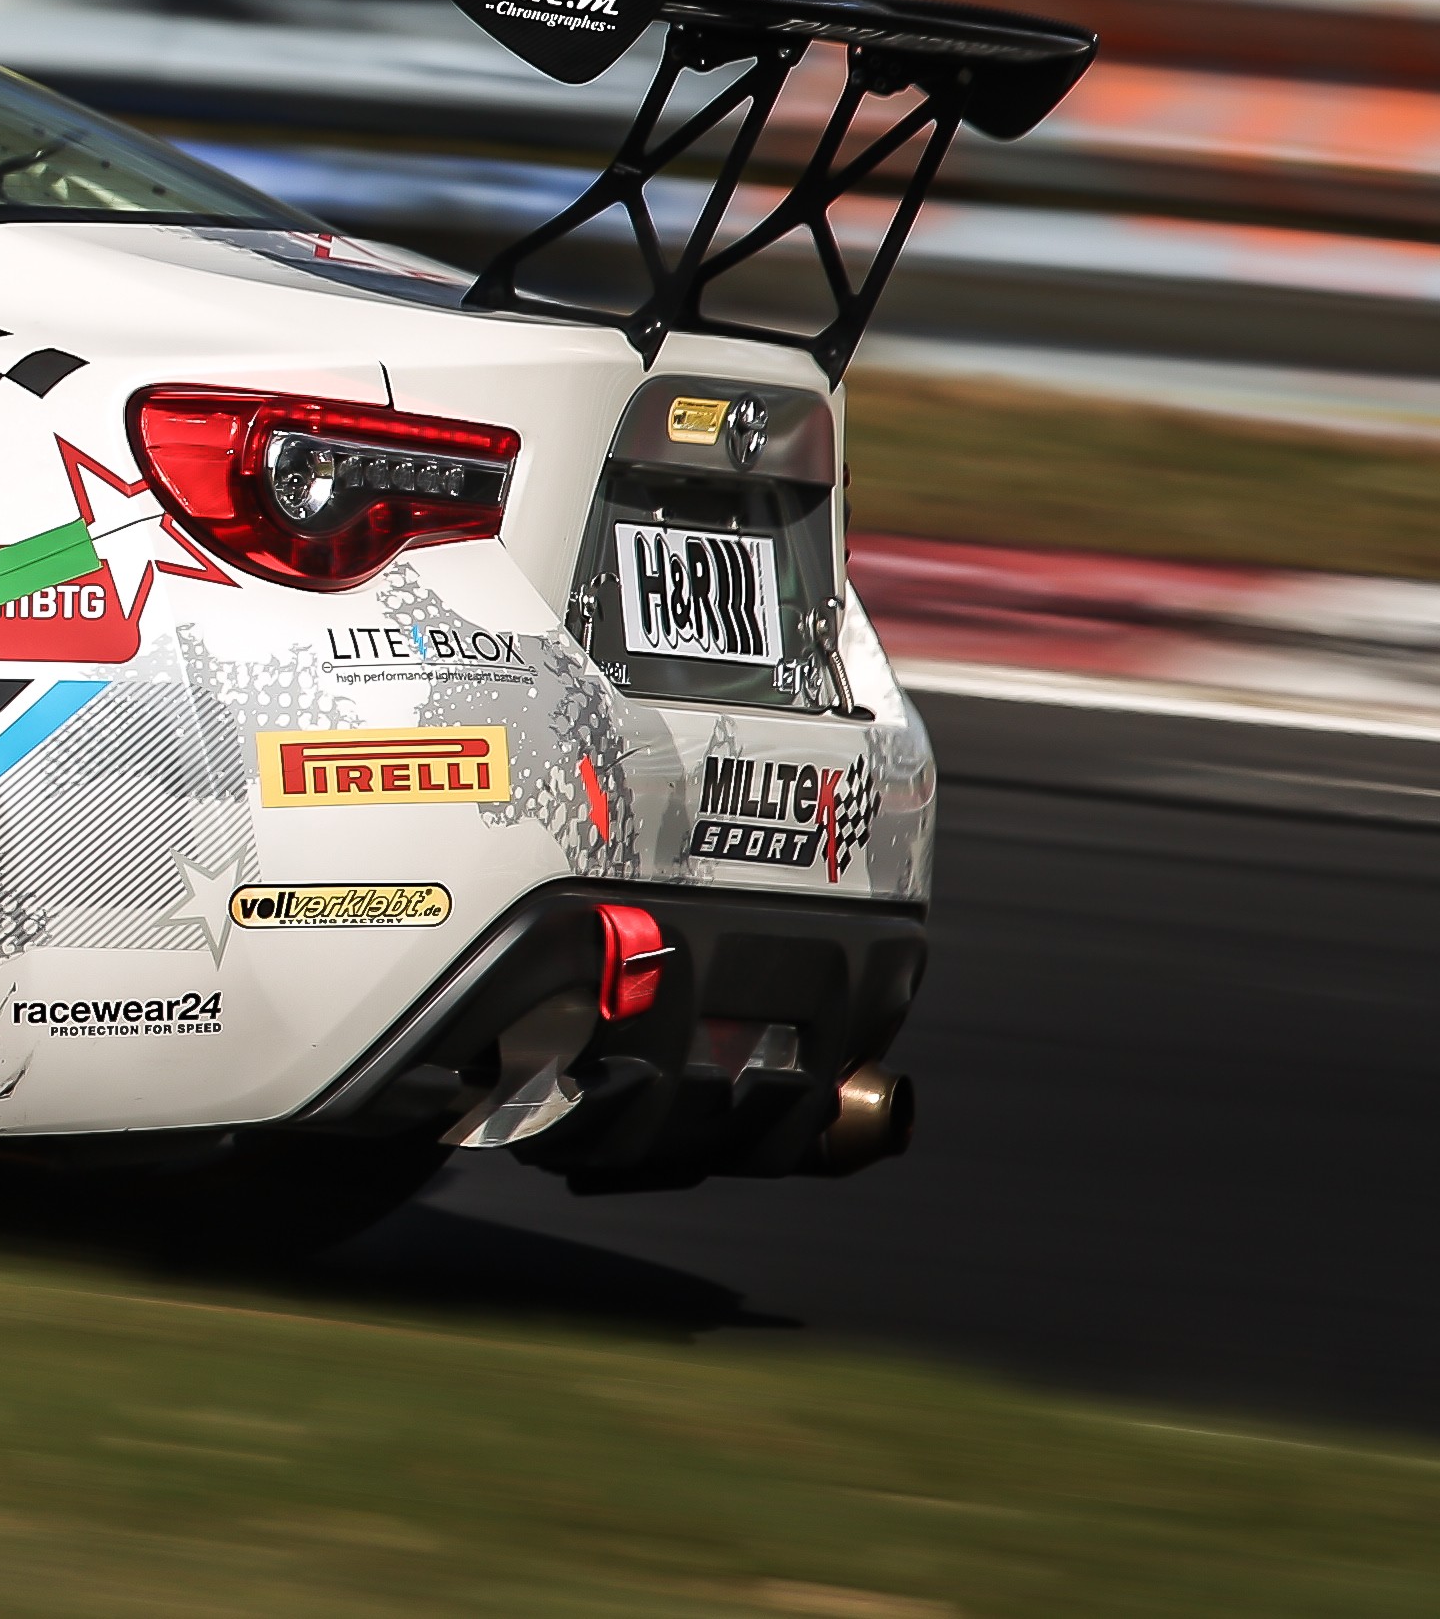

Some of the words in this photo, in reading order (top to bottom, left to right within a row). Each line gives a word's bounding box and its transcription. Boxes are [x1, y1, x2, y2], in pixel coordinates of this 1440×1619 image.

[327, 628, 409, 659] LITE
[429, 629, 524, 665] BLOX
[336, 672, 361, 684] high
[280, 738, 490, 795] PIRELLI
[700, 826, 808, 860] SPORT
[13, 992, 221, 1024] racewear24
[51, 1025, 138, 1036] PROTECTION
[144, 1024, 172, 1035] FOR
[178, 1022, 221, 1034] SPEED
